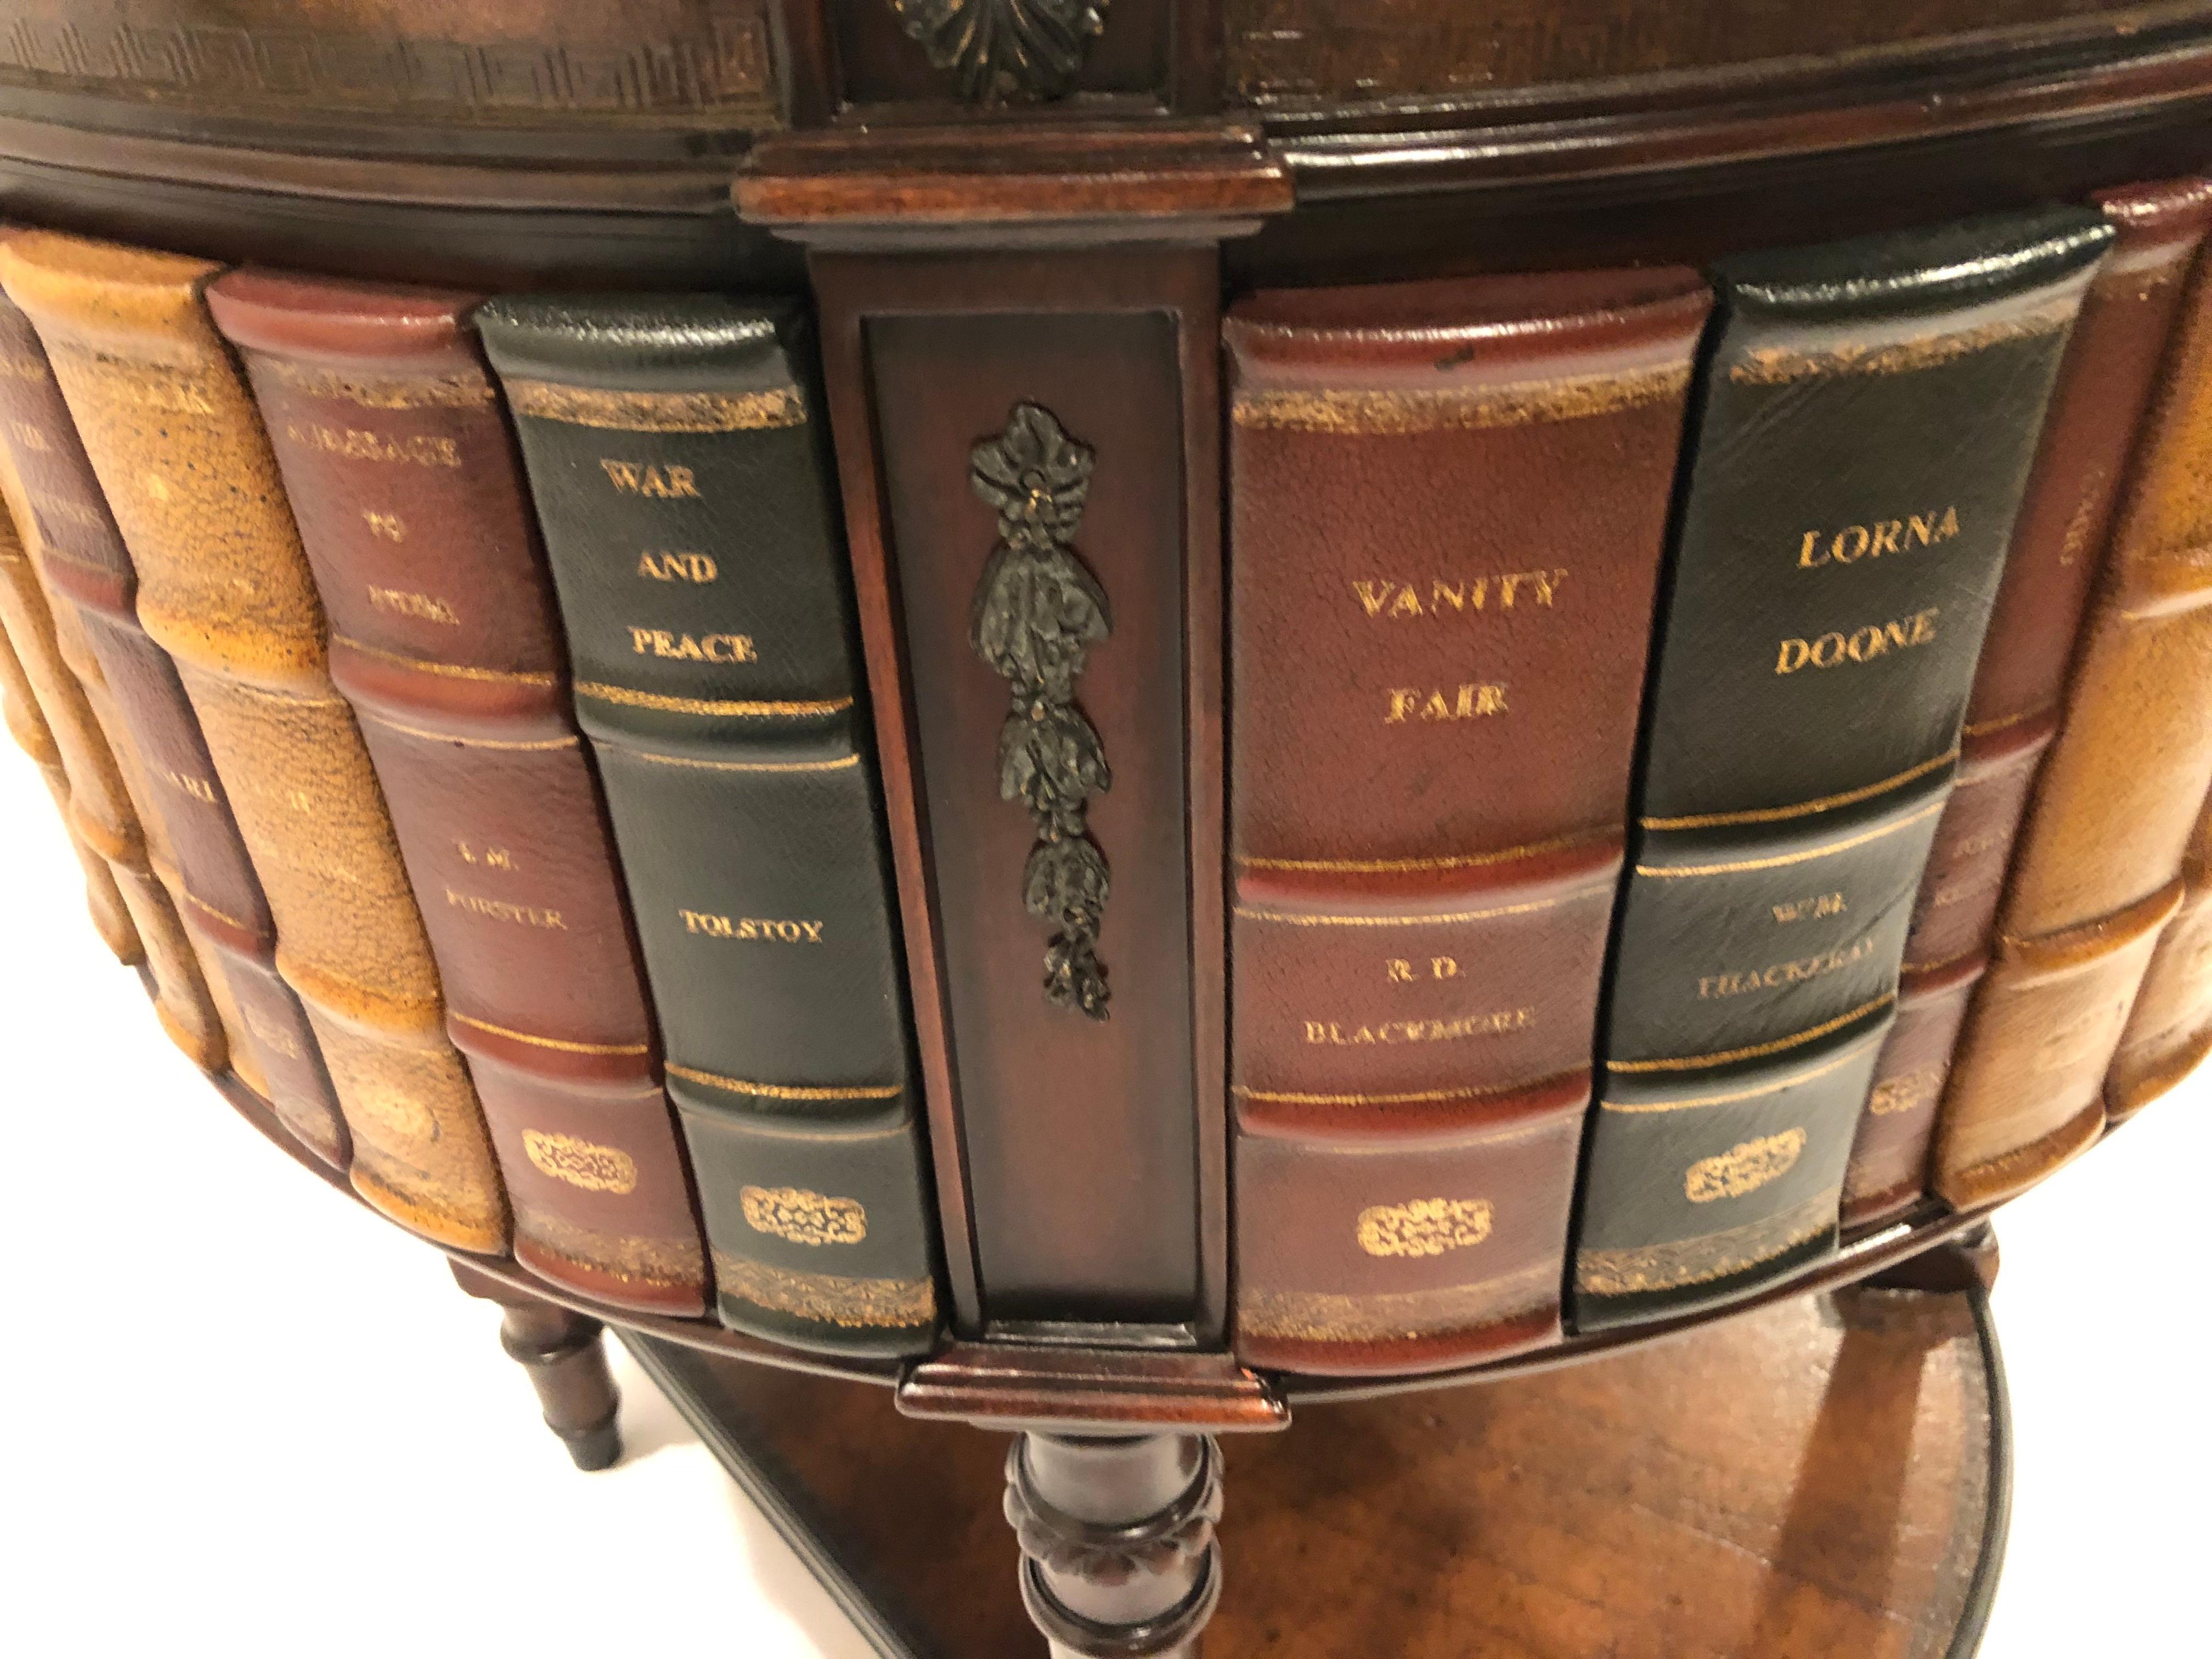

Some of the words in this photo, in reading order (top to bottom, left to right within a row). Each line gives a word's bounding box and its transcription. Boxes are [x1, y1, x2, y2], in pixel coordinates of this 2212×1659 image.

[600, 458, 703, 499] WAR
[1796, 505, 1960, 570] LORNA
[637, 549, 718, 584] AND
[1352, 567, 1570, 619] VANITY
[627, 624, 759, 665] PEACE
[1774, 606, 1940, 675] DOONE
[1384, 680, 1510, 725] FAIR
[678, 909, 824, 944] TOLSTOY
